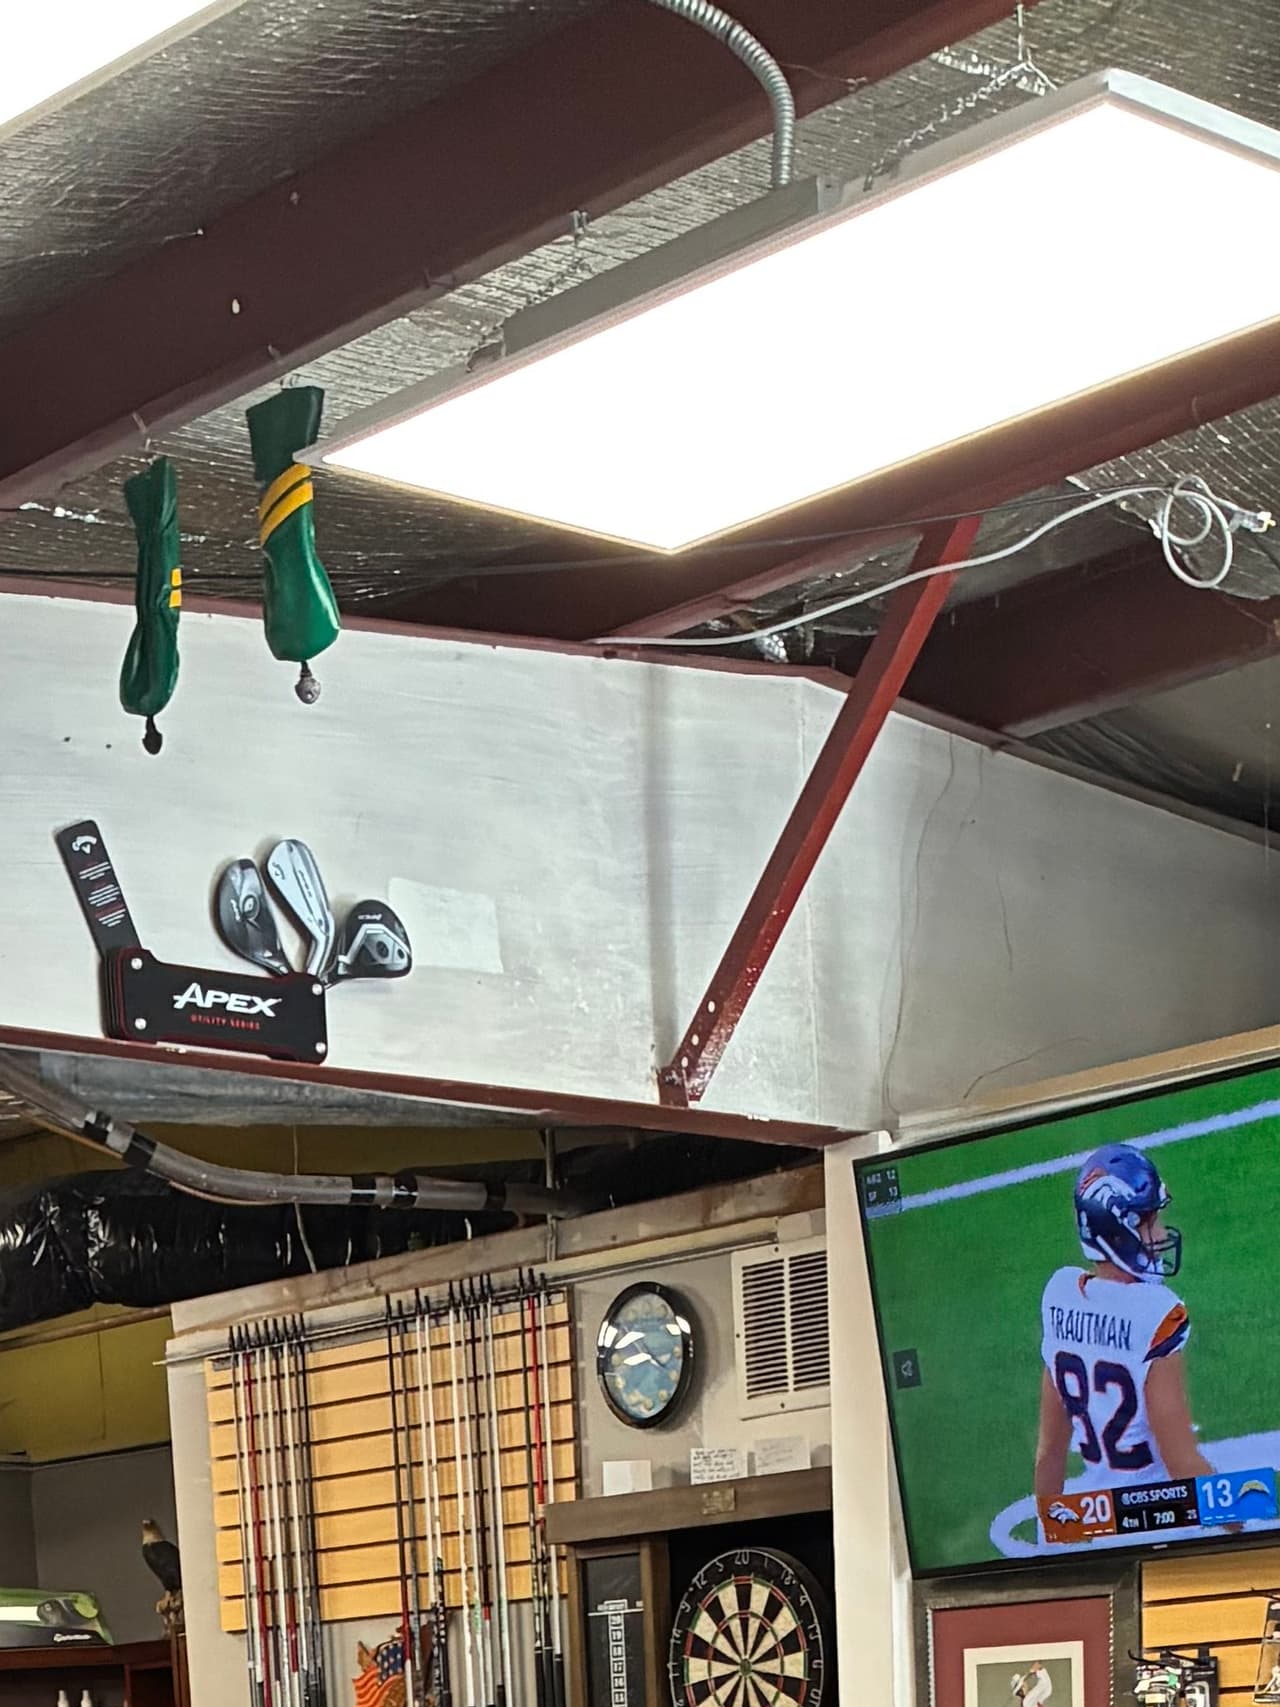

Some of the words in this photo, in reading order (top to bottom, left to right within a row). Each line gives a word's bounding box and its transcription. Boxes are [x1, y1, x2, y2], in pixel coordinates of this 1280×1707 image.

[173, 982, 282, 1018] APEX
[1050, 1306, 1132, 1350] TRAUTMAN
[1150, 1486, 1189, 1502] SPORTS
[1202, 1478, 1234, 1509] 13
[1080, 1495, 1112, 1525] 20
[1153, 1510, 1176, 1525] 7:00
